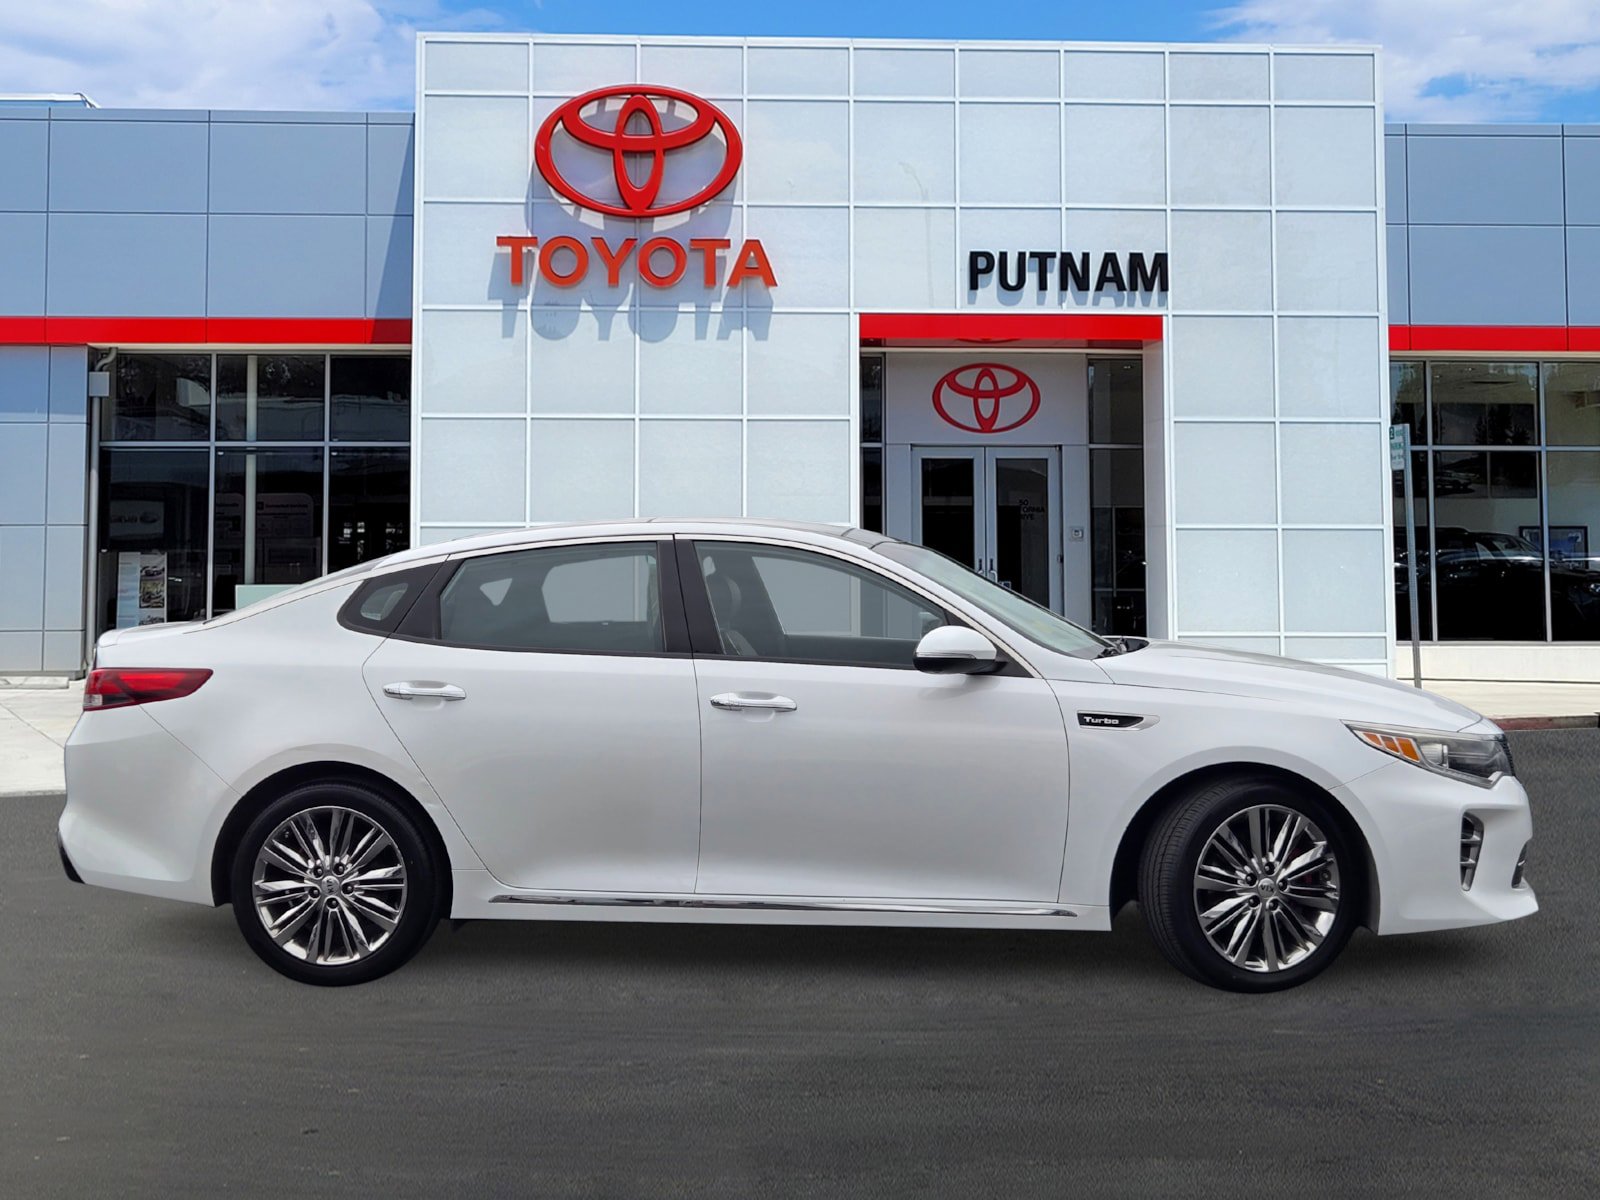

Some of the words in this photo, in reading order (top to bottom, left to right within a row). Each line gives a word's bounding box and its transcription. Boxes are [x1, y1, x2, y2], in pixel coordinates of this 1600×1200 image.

[496, 236, 778, 287] TOYOTA
[969, 251, 1169, 292] PUTNAM
[1083, 716, 1120, 725] Turbo
